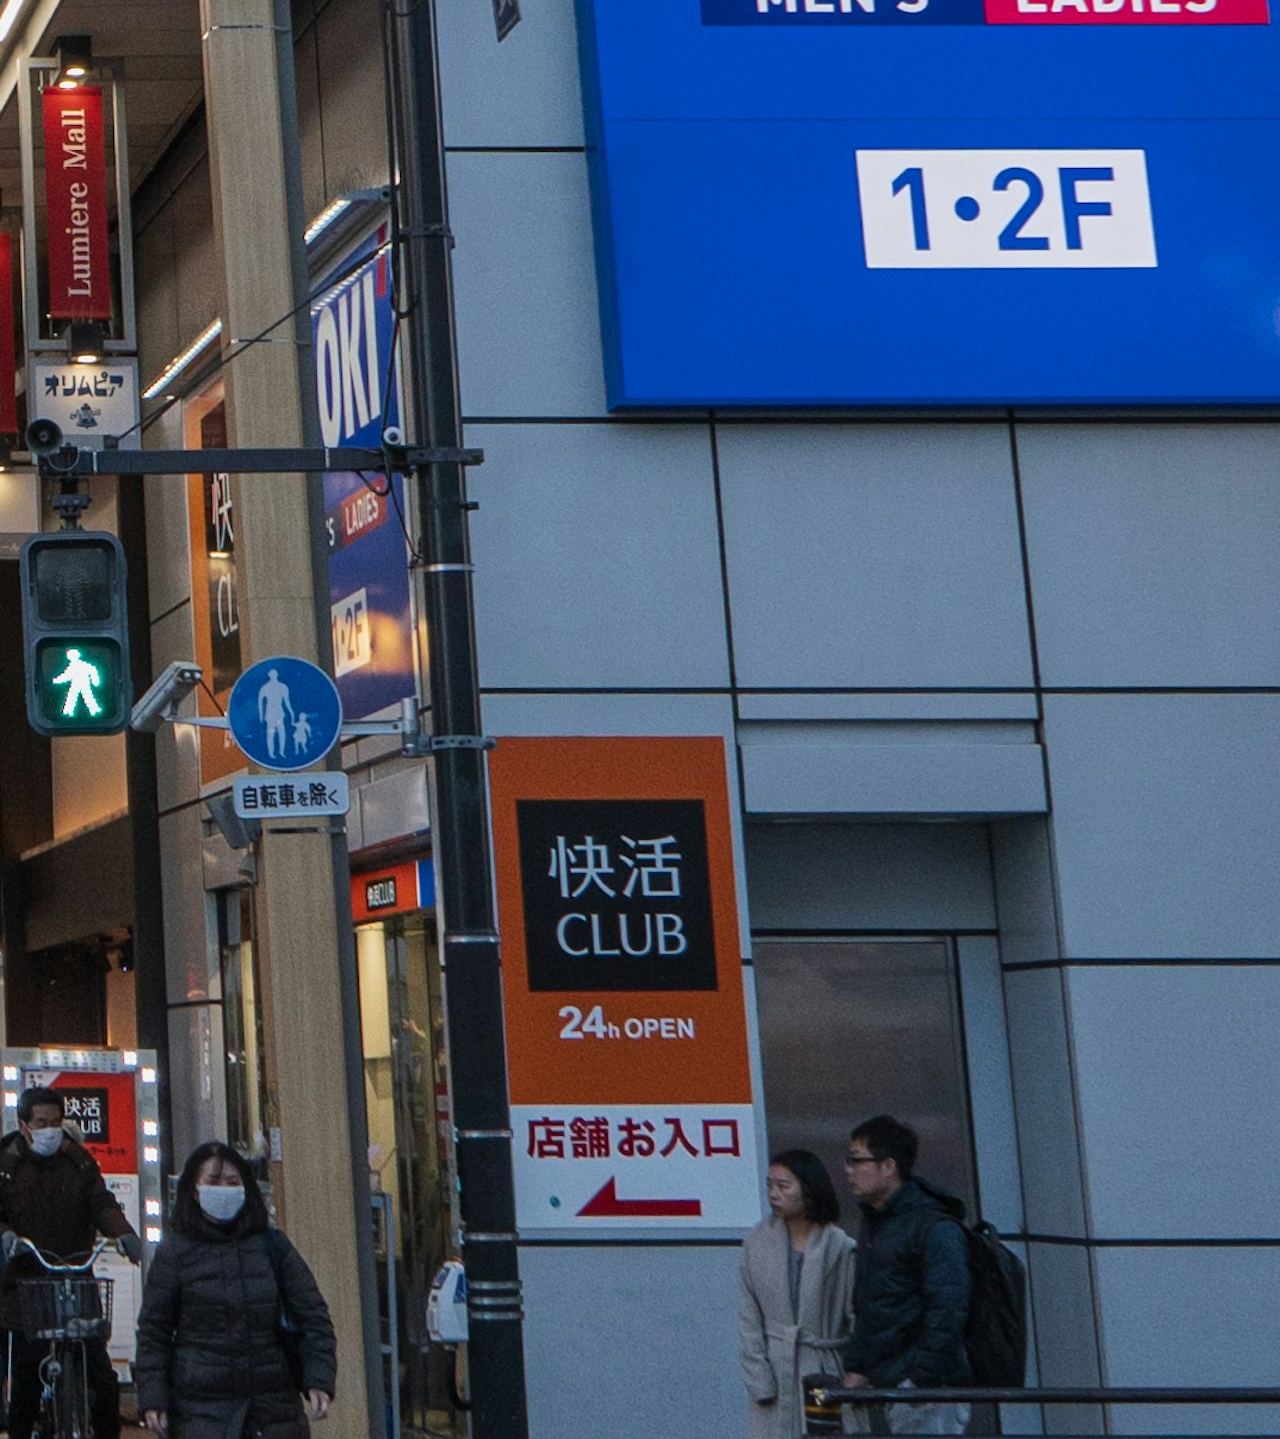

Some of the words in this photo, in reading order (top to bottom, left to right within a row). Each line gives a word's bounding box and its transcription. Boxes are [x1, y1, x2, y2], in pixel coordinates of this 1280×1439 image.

[61, 108, 87, 170] Mall
[67, 181, 93, 298] Lumiere
[44, 371, 125, 398] オリムピア
[241, 784, 338, 810] 自転車を除く
[548, 835, 683, 899] 快活
[556, 912, 688, 956] CLUB
[558, 1004, 621, 1041] 24h
[624, 1017, 695, 1040] OPEN
[526, 1117, 741, 1159] 店舗お入口
